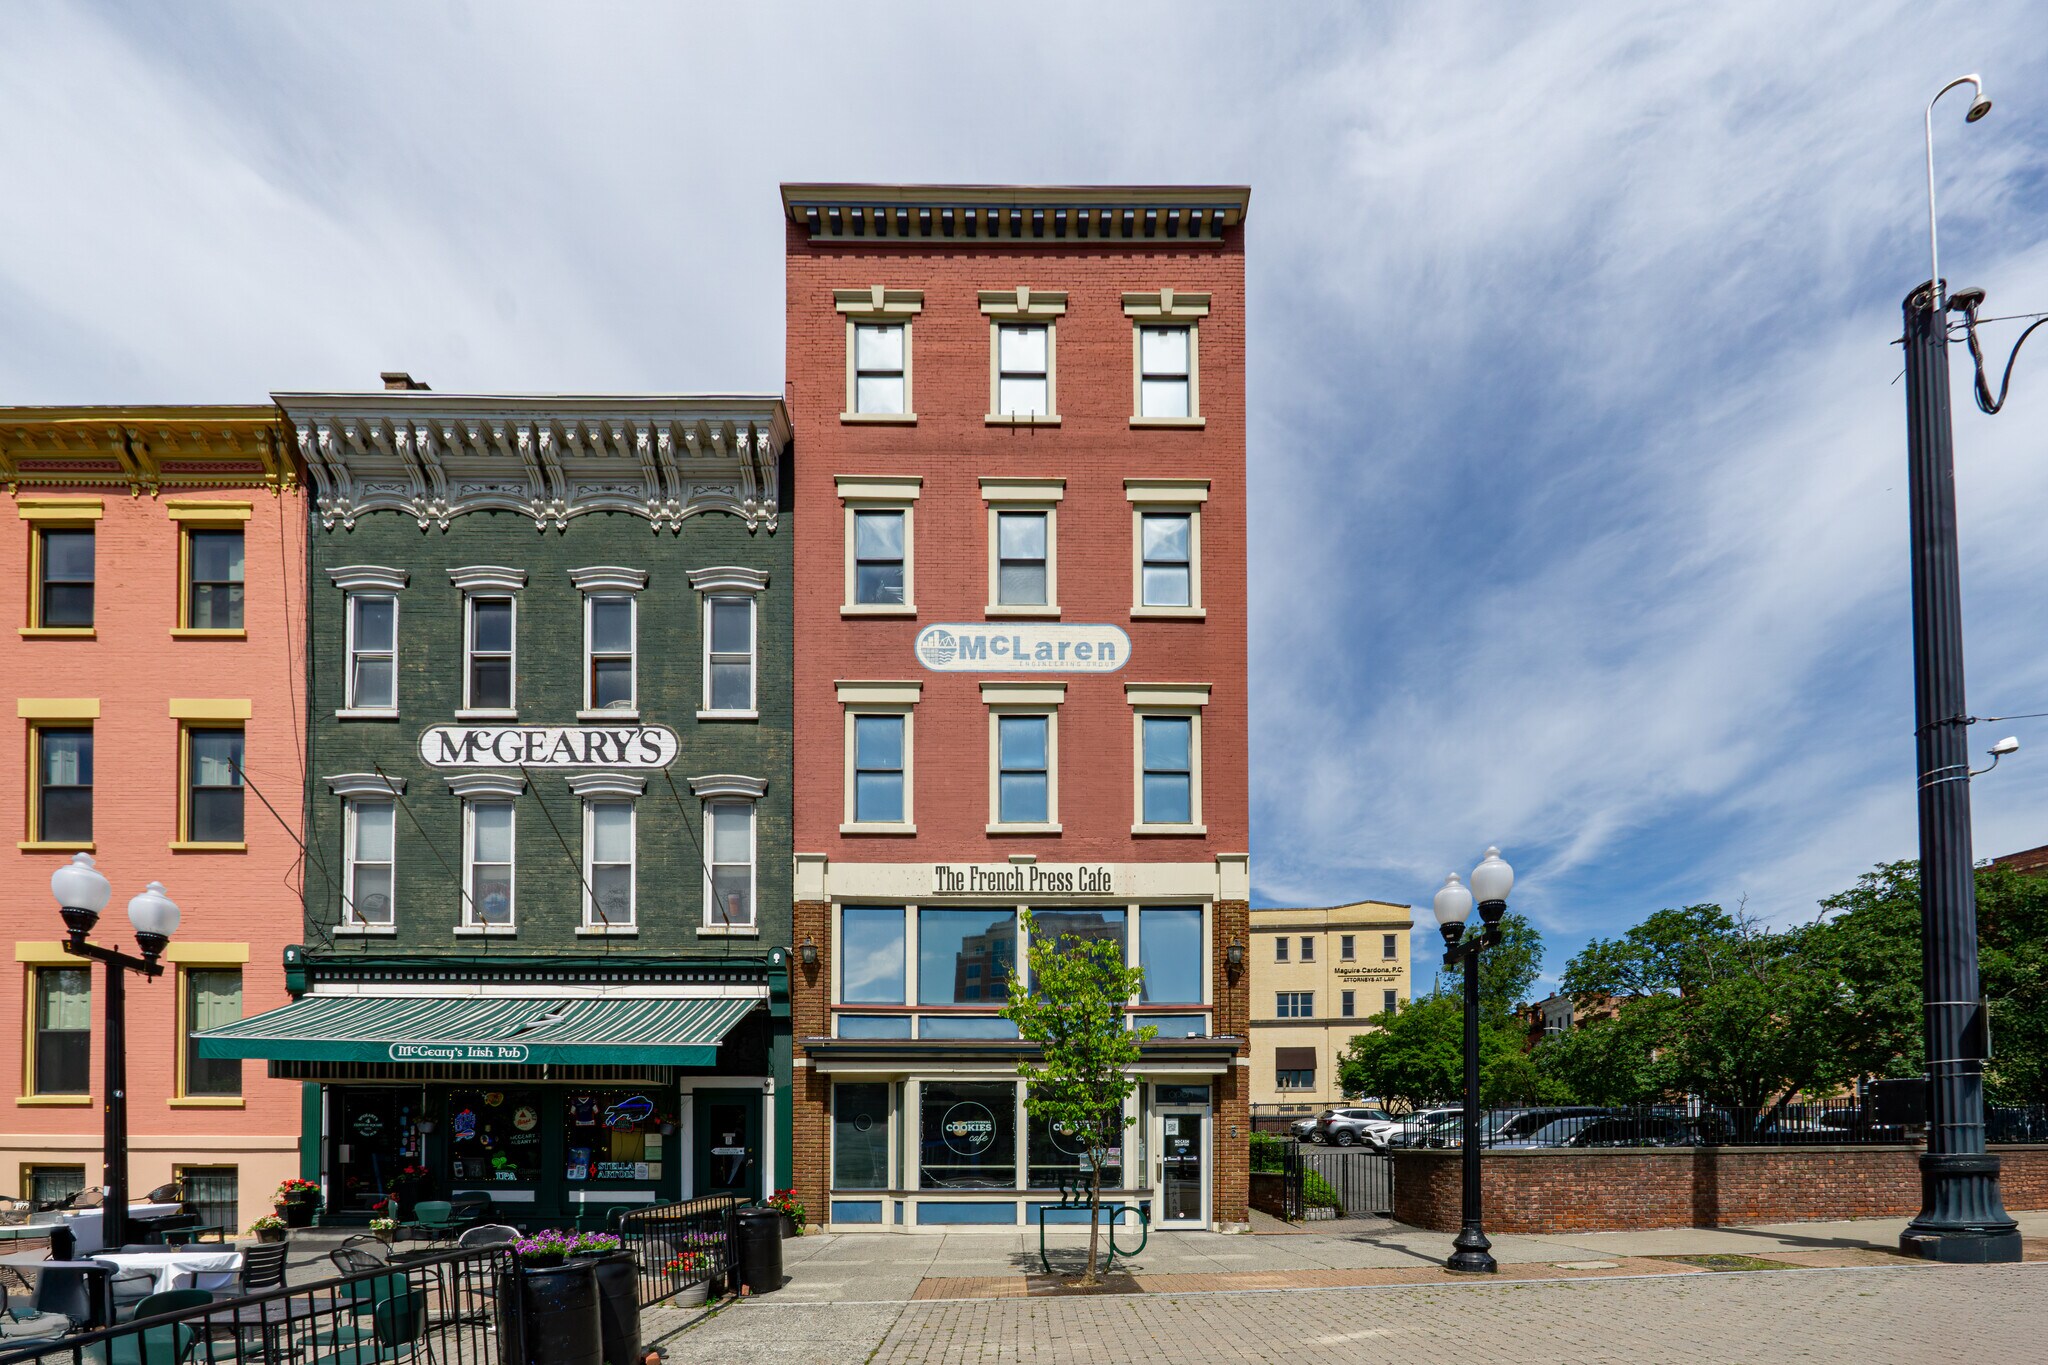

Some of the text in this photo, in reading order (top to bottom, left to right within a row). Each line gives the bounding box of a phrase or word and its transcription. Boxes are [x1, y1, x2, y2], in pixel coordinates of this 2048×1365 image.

[959, 635, 1116, 660] McLaren
[1086, 660, 1116, 668] GROUP
[935, 866, 1111, 891] The French Press Cafe
[467, 1046, 494, 1058] Irish
[498, 1047, 521, 1058] Pub
[945, 1123, 992, 1132] COOKIES
[968, 1131, 989, 1145] cafe
[597, 1162, 635, 1170] STELLA
[495, 1171, 517, 1180] IPA
